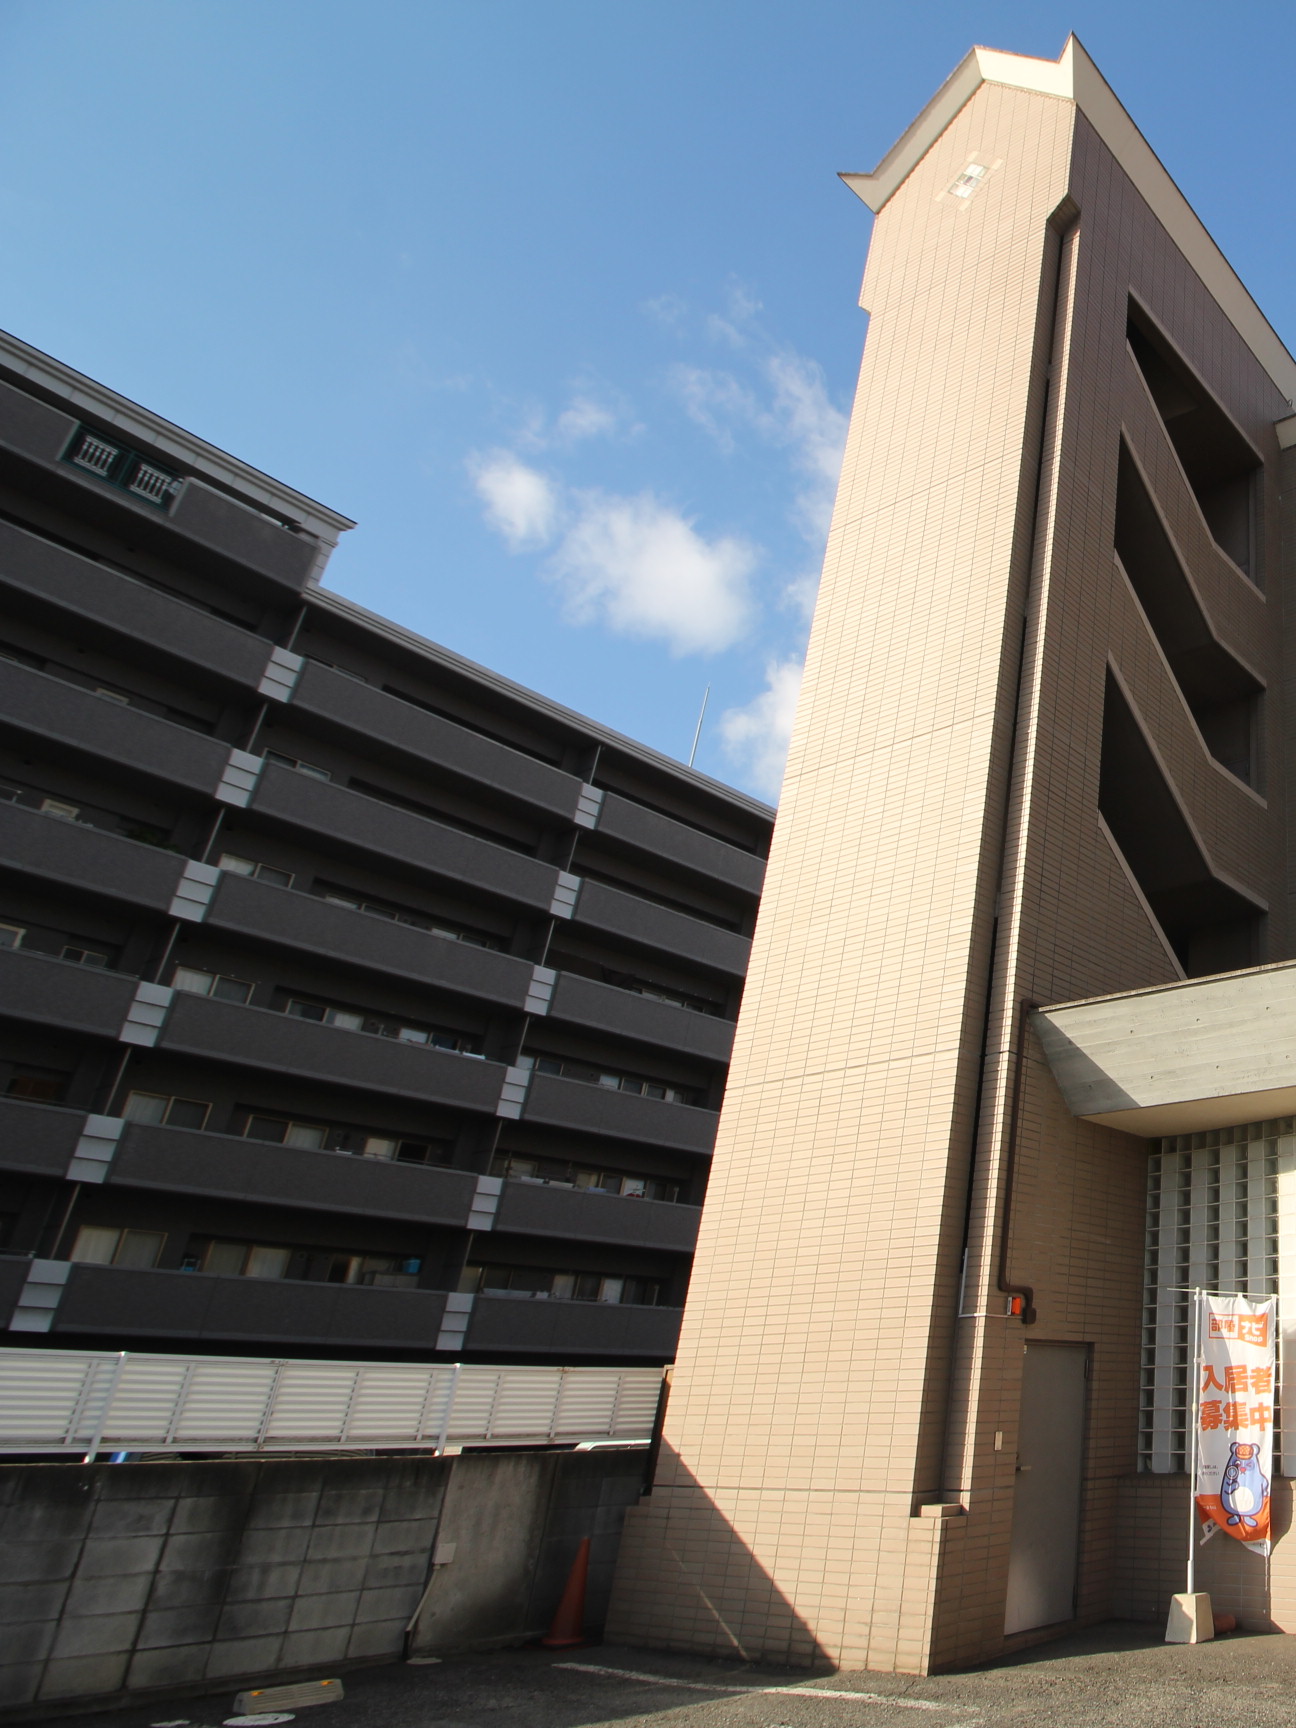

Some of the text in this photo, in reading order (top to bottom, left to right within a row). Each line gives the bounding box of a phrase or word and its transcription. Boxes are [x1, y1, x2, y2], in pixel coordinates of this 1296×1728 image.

[1201, 1364, 1273, 1395] 入居者
[1199, 1399, 1273, 1432] 募集中
